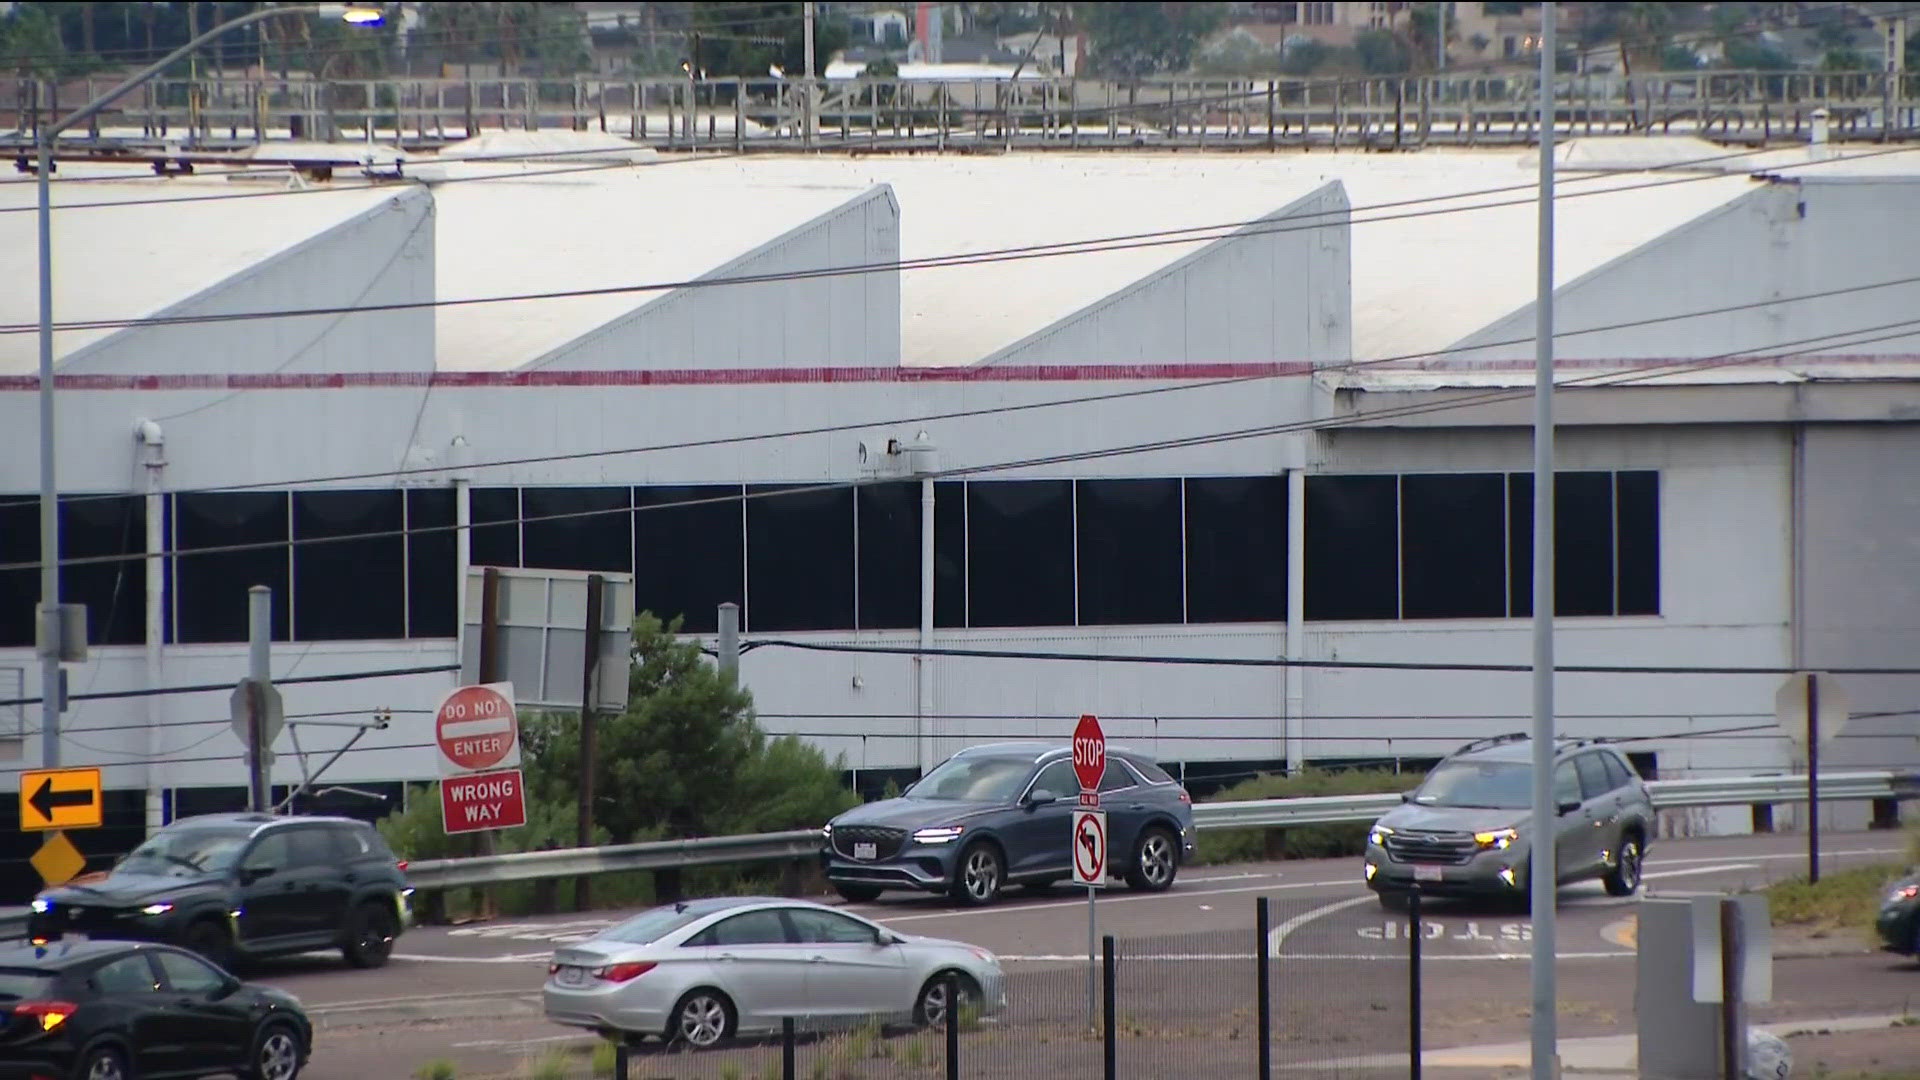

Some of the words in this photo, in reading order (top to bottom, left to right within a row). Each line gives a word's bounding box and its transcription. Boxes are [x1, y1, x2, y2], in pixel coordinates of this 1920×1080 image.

[445, 704, 466, 719] DO
[474, 700, 503, 716] NOT
[454, 738, 501, 756] ENTER
[1075, 737, 1103, 767] STOP
[451, 780, 514, 803] WRONG
[465, 803, 503, 823] WAY
[1357, 920, 1532, 940] STOP
